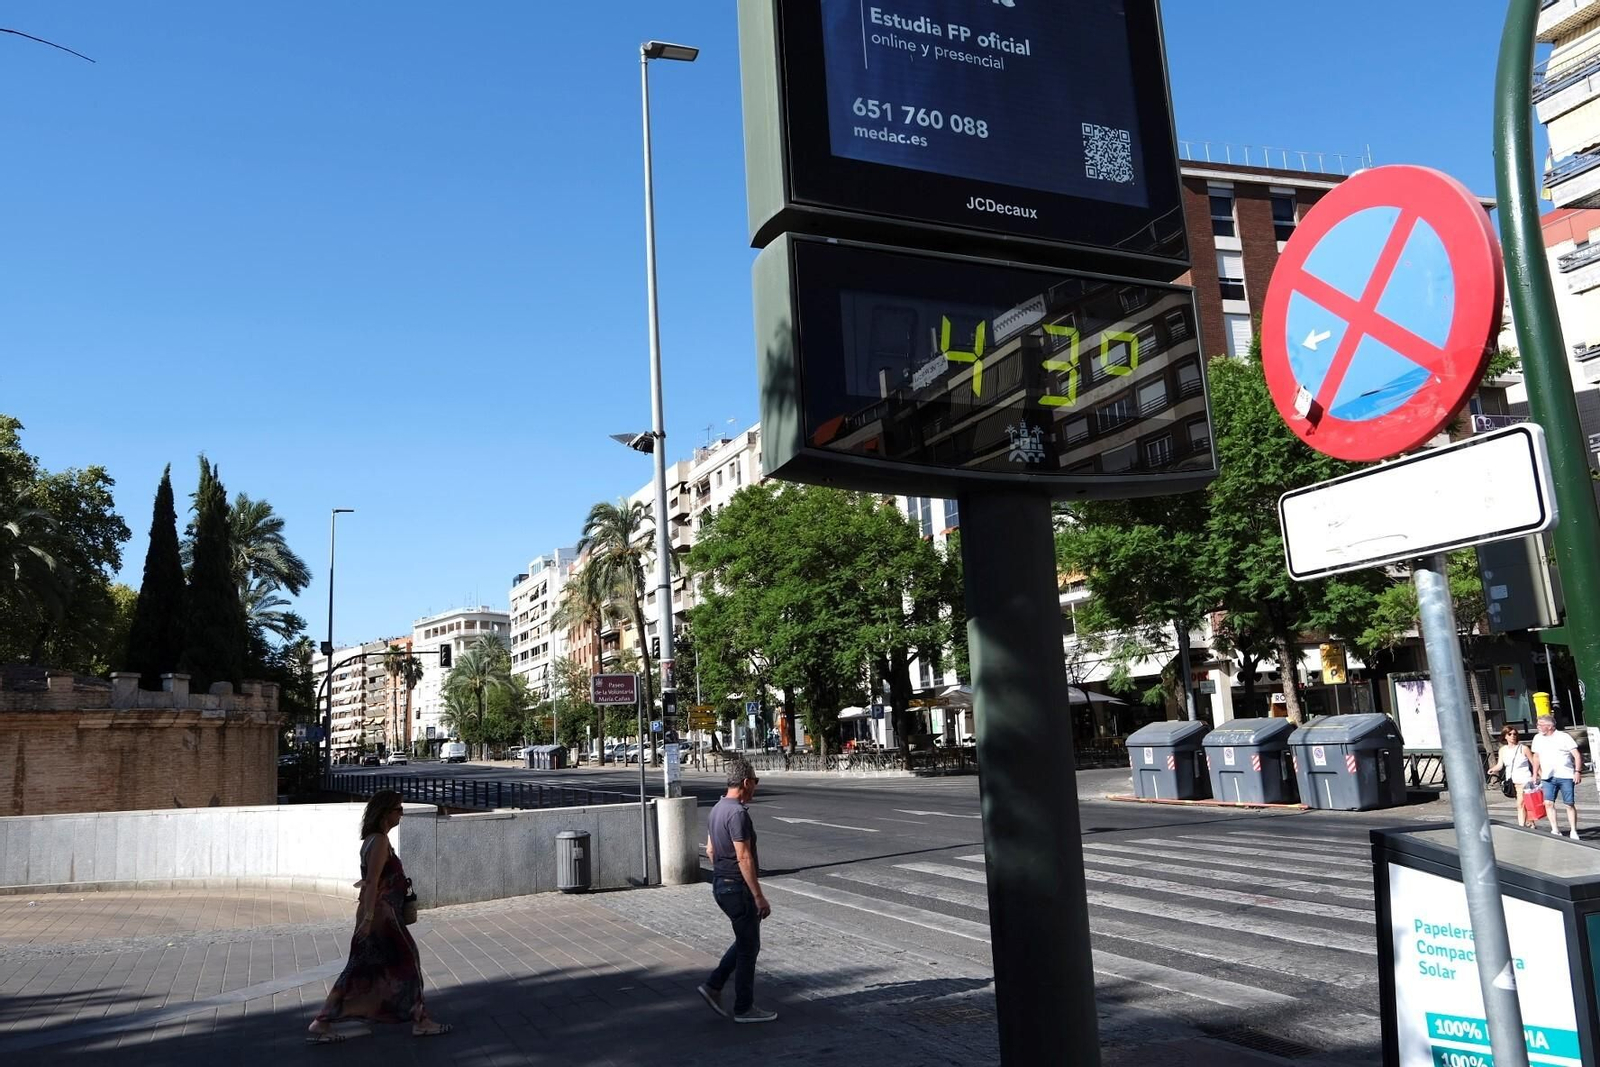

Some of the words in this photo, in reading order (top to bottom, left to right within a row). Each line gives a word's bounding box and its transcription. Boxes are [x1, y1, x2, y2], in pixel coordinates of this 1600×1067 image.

[870, 7, 942, 36] Estudia
[947, 23, 971, 42] FP
[977, 32, 1031, 56] oficial
[871, 33, 917, 52] online
[921, 43, 930, 57] y
[934, 46, 1005, 70] presencial
[852, 97, 893, 121] 651
[901, 105, 944, 129] 760
[949, 114, 989, 138] 088
[853, 126, 928, 147] medac.es
[966, 196, 1038, 219] JCDecaux
[652, 722, 660, 731] P
[1414, 919, 1475, 940] Papelera
[1419, 960, 1456, 980] Solar
[1434, 1019, 1483, 1040] 100%
